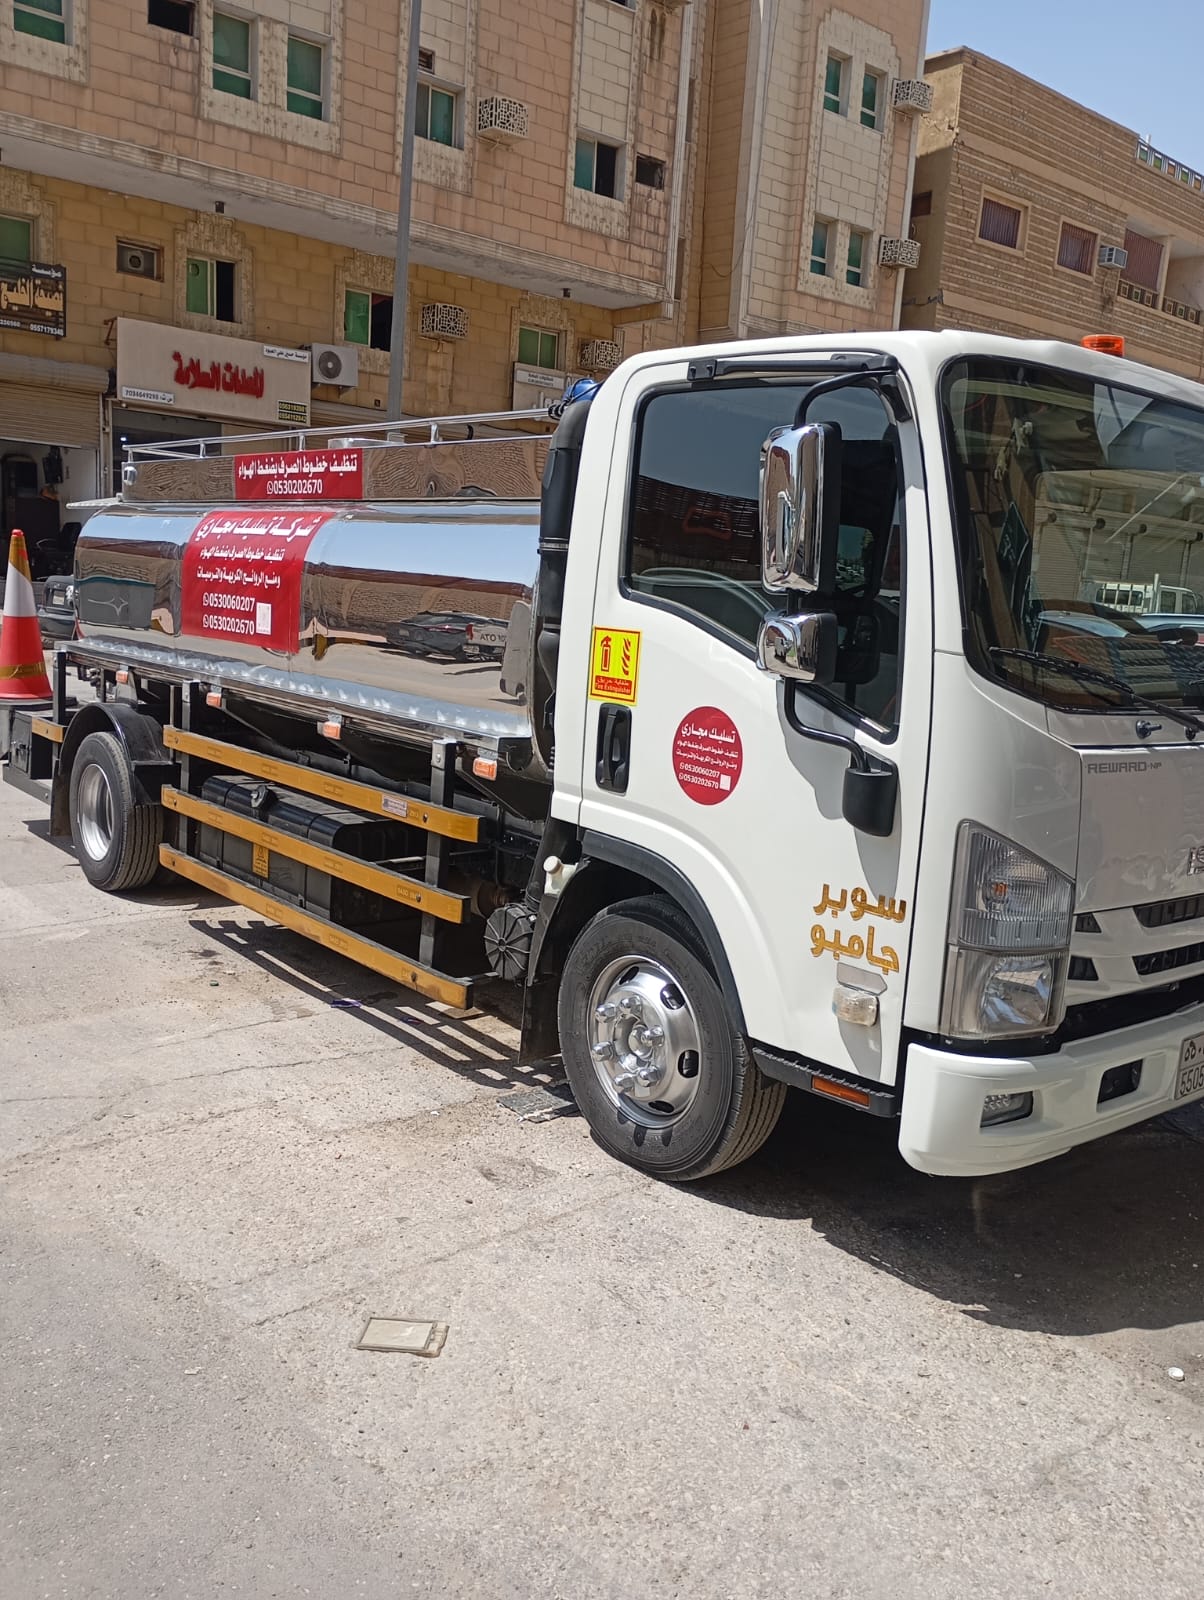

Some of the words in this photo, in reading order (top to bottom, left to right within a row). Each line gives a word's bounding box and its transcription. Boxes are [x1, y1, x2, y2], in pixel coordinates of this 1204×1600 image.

[32, 264, 62, 278] مؤسسة
[0, 276, 34, 311] الخليج
[171, 350, 220, 392] السلامة
[238, 459, 257, 480] الهواء
[257, 457, 278, 479] بضغط
[278, 456, 302, 478] الصرف
[302, 455, 328, 477] خطوط
[329, 453, 358, 477] تنظيف
[273, 479, 323, 495] 0530202670
[195, 517, 235, 542] مجاري
[232, 517, 279, 540] تسليك
[269, 515, 322, 542] شركة
[199, 545, 216, 560] الهواء
[214, 545, 231, 560] بضغط
[229, 545, 247, 561] الصرف
[245, 546, 265, 562] خطوط
[264, 548, 286, 564] تنظيف
[221, 566, 243, 585] الكريهة
[242, 568, 265, 588] الروائح
[264, 571, 281, 589] ومنع
[209, 592, 256, 613] 0530060207
[209, 615, 255, 635] 0530202670
[681, 722, 708, 740] مجاري
[708, 728, 737, 744] تسليك
[684, 762, 720, 778] 0530060207
[1087, 761, 1147, 774] REWARD
[812, 883, 907, 924] سوبر
[810, 924, 900, 976] جامبو
